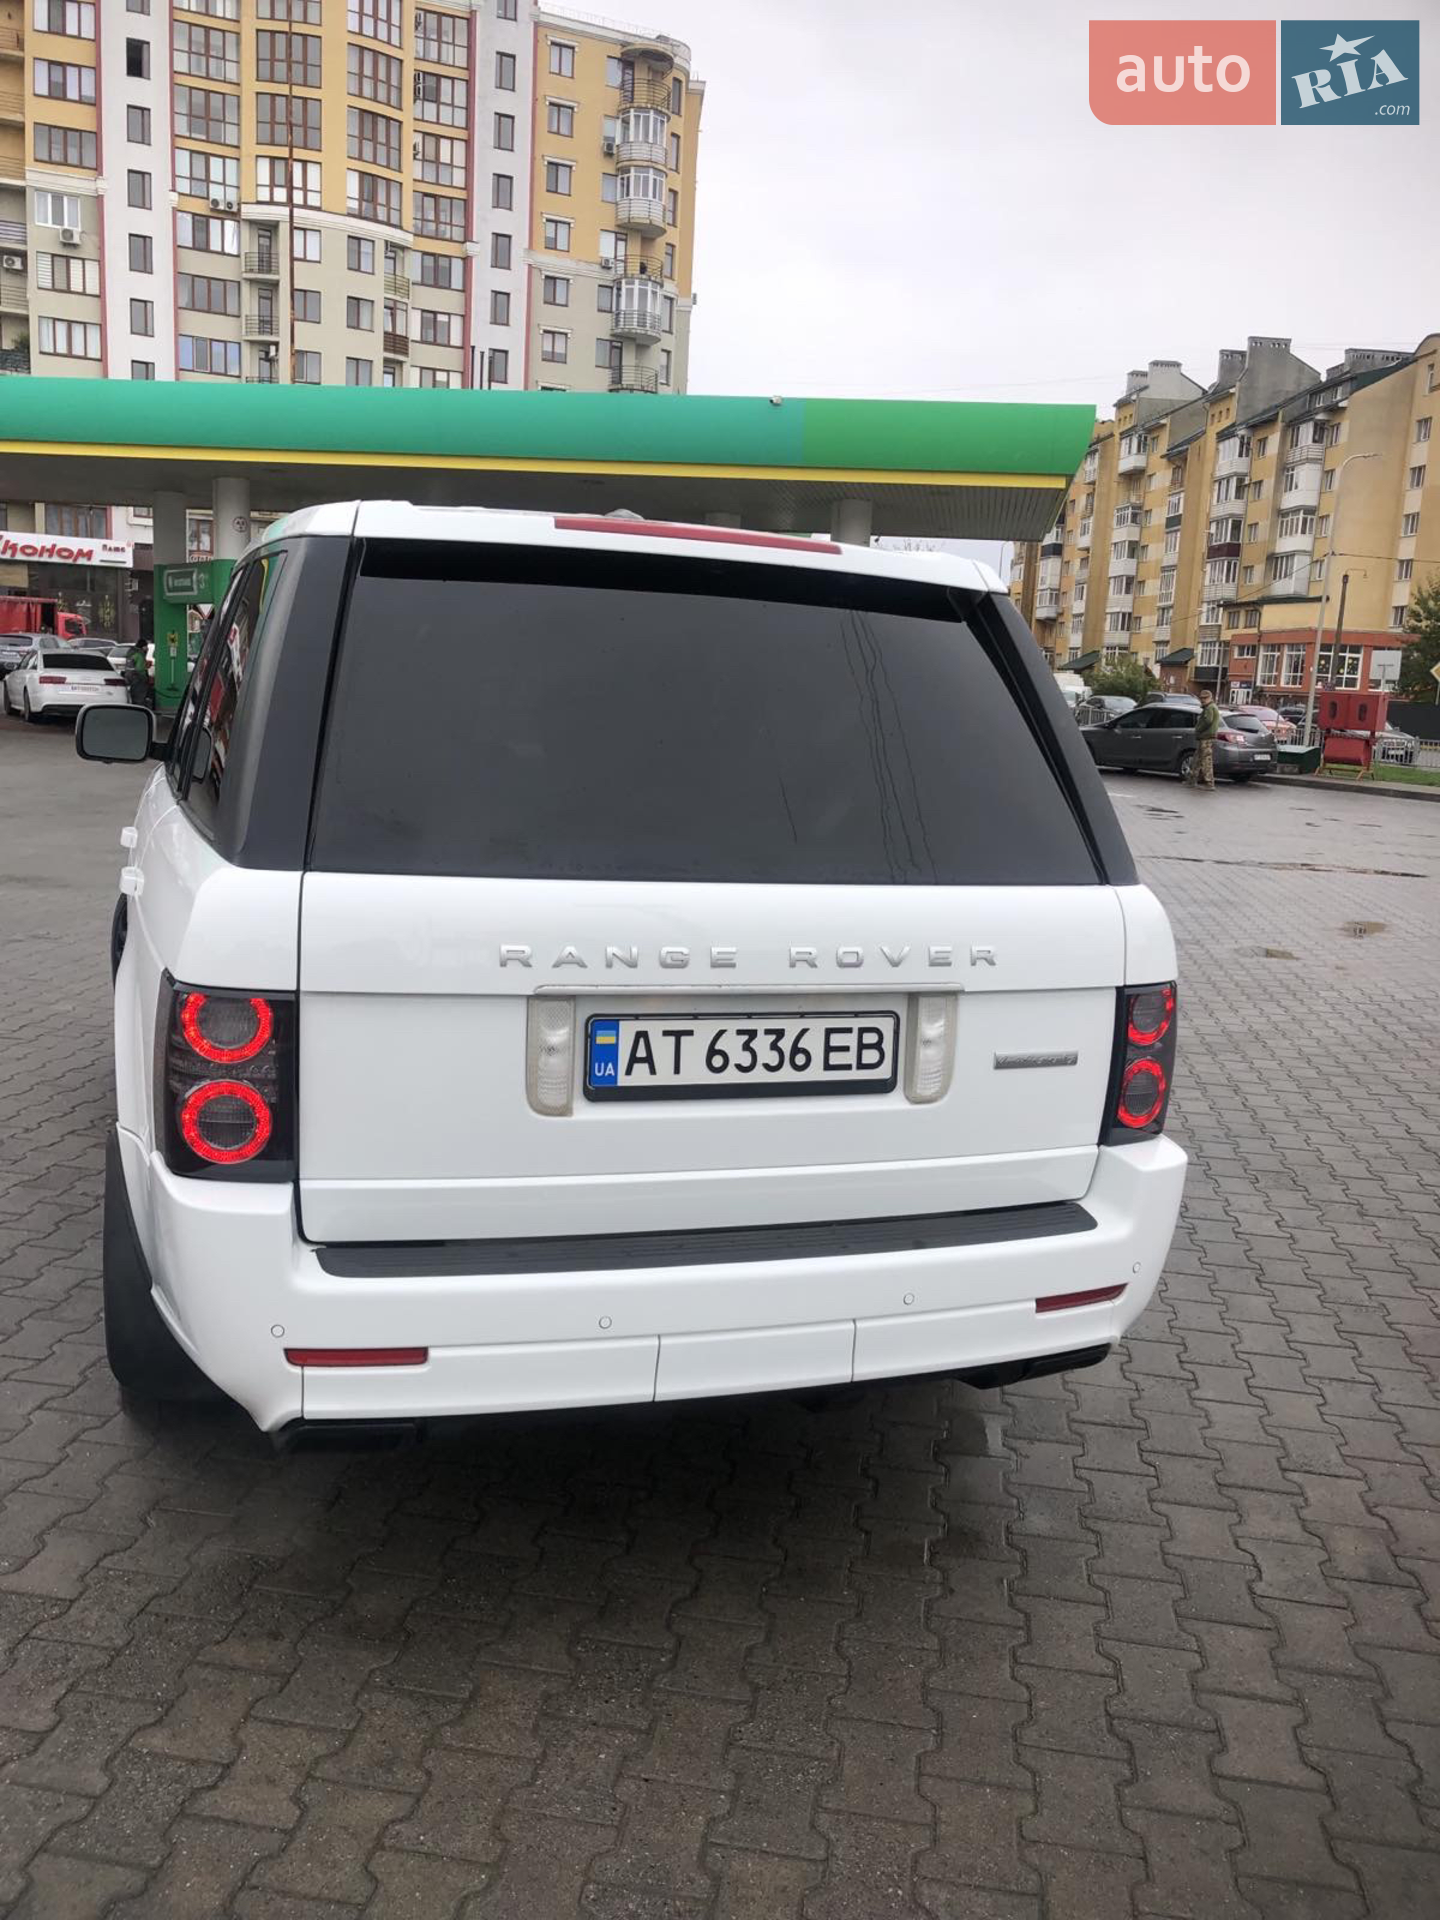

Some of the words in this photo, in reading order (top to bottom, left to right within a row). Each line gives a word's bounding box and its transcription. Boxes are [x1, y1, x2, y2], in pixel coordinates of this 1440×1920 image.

[0, 534, 94, 563] коном
[499, 945, 738, 969] RANGE
[788, 945, 997, 969] ROVER
[624, 1029, 695, 1076] AT
[705, 1027, 812, 1074] 6336
[823, 1026, 886, 1072] EB
[594, 1061, 616, 1077] UA
